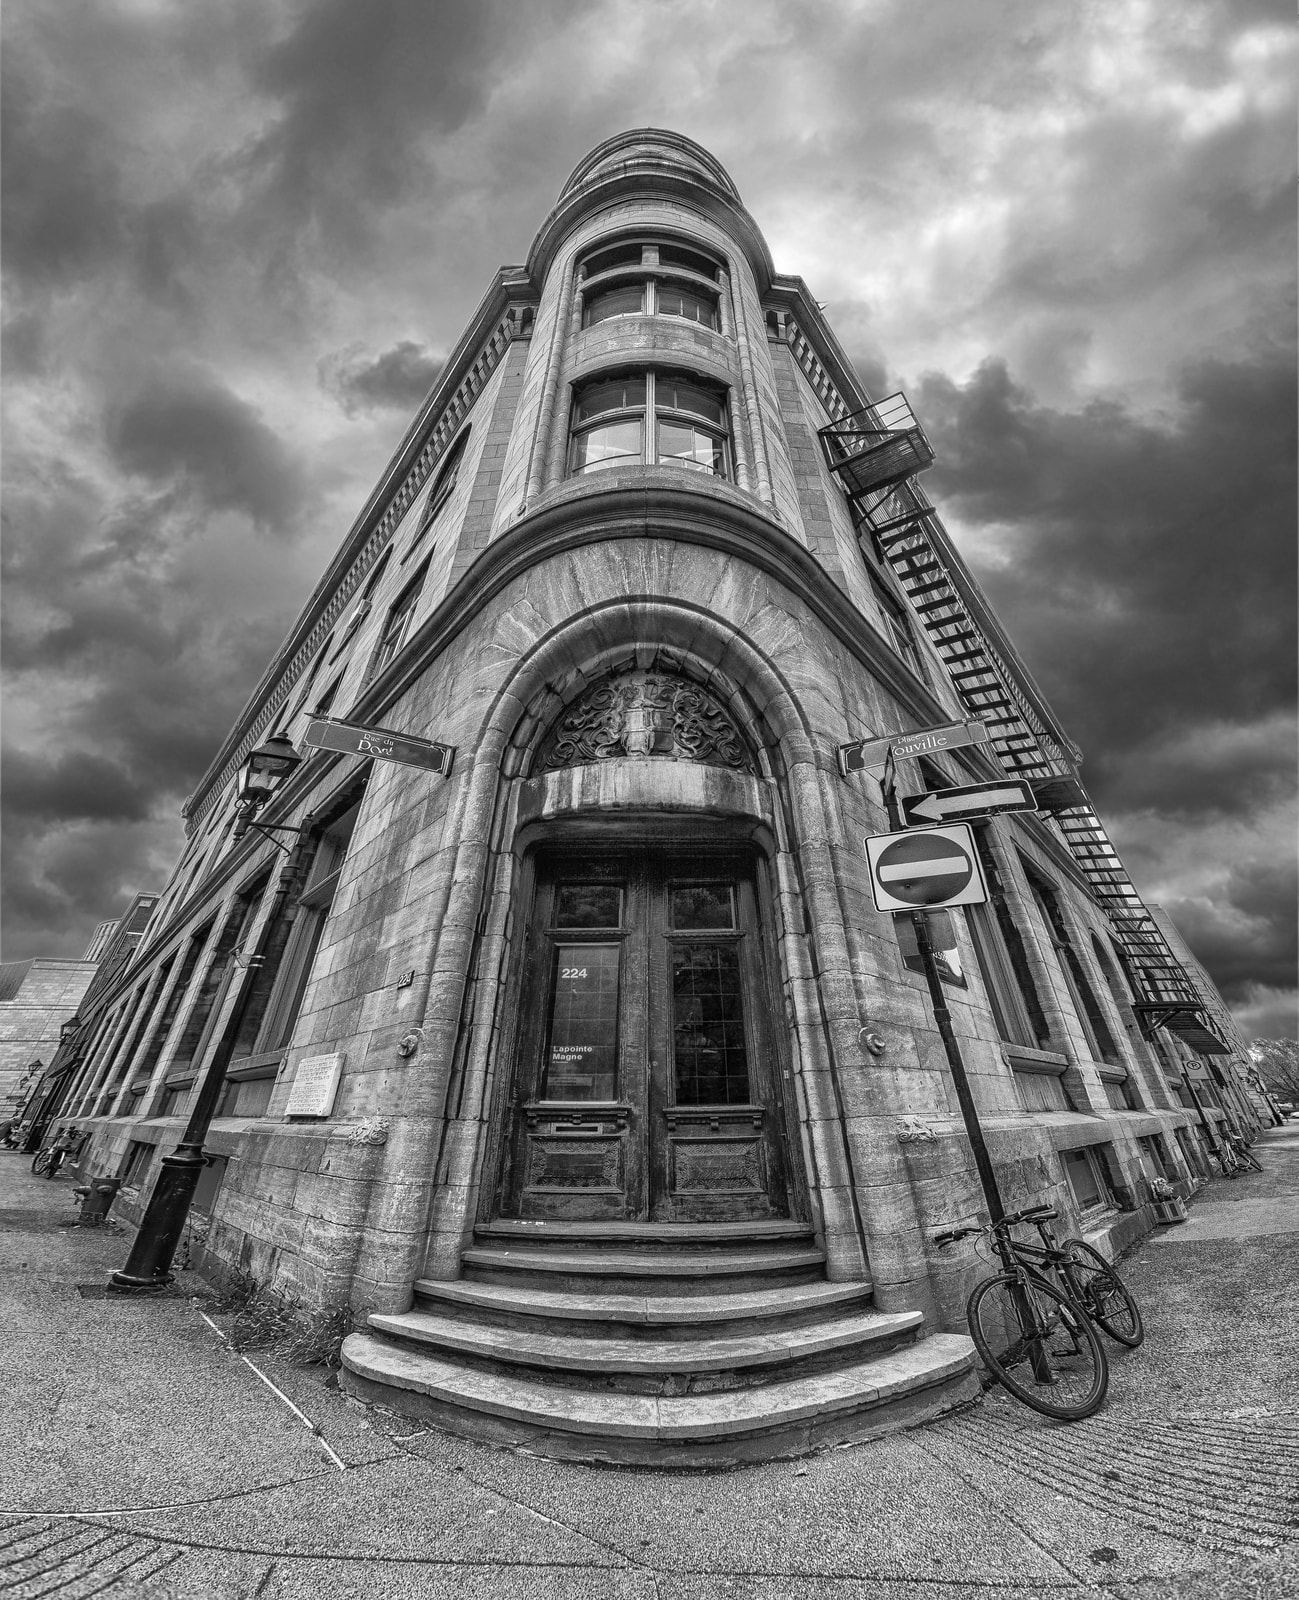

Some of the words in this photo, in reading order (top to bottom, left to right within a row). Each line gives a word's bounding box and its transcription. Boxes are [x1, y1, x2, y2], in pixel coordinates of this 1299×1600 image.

[363, 733, 381, 742] Rue
[383, 738, 394, 746] du
[357, 739, 393, 756] Port
[561, 968, 588, 979] 224
[553, 1045, 593, 1053] Lapointe
[552, 1053, 583, 1061] Magne
